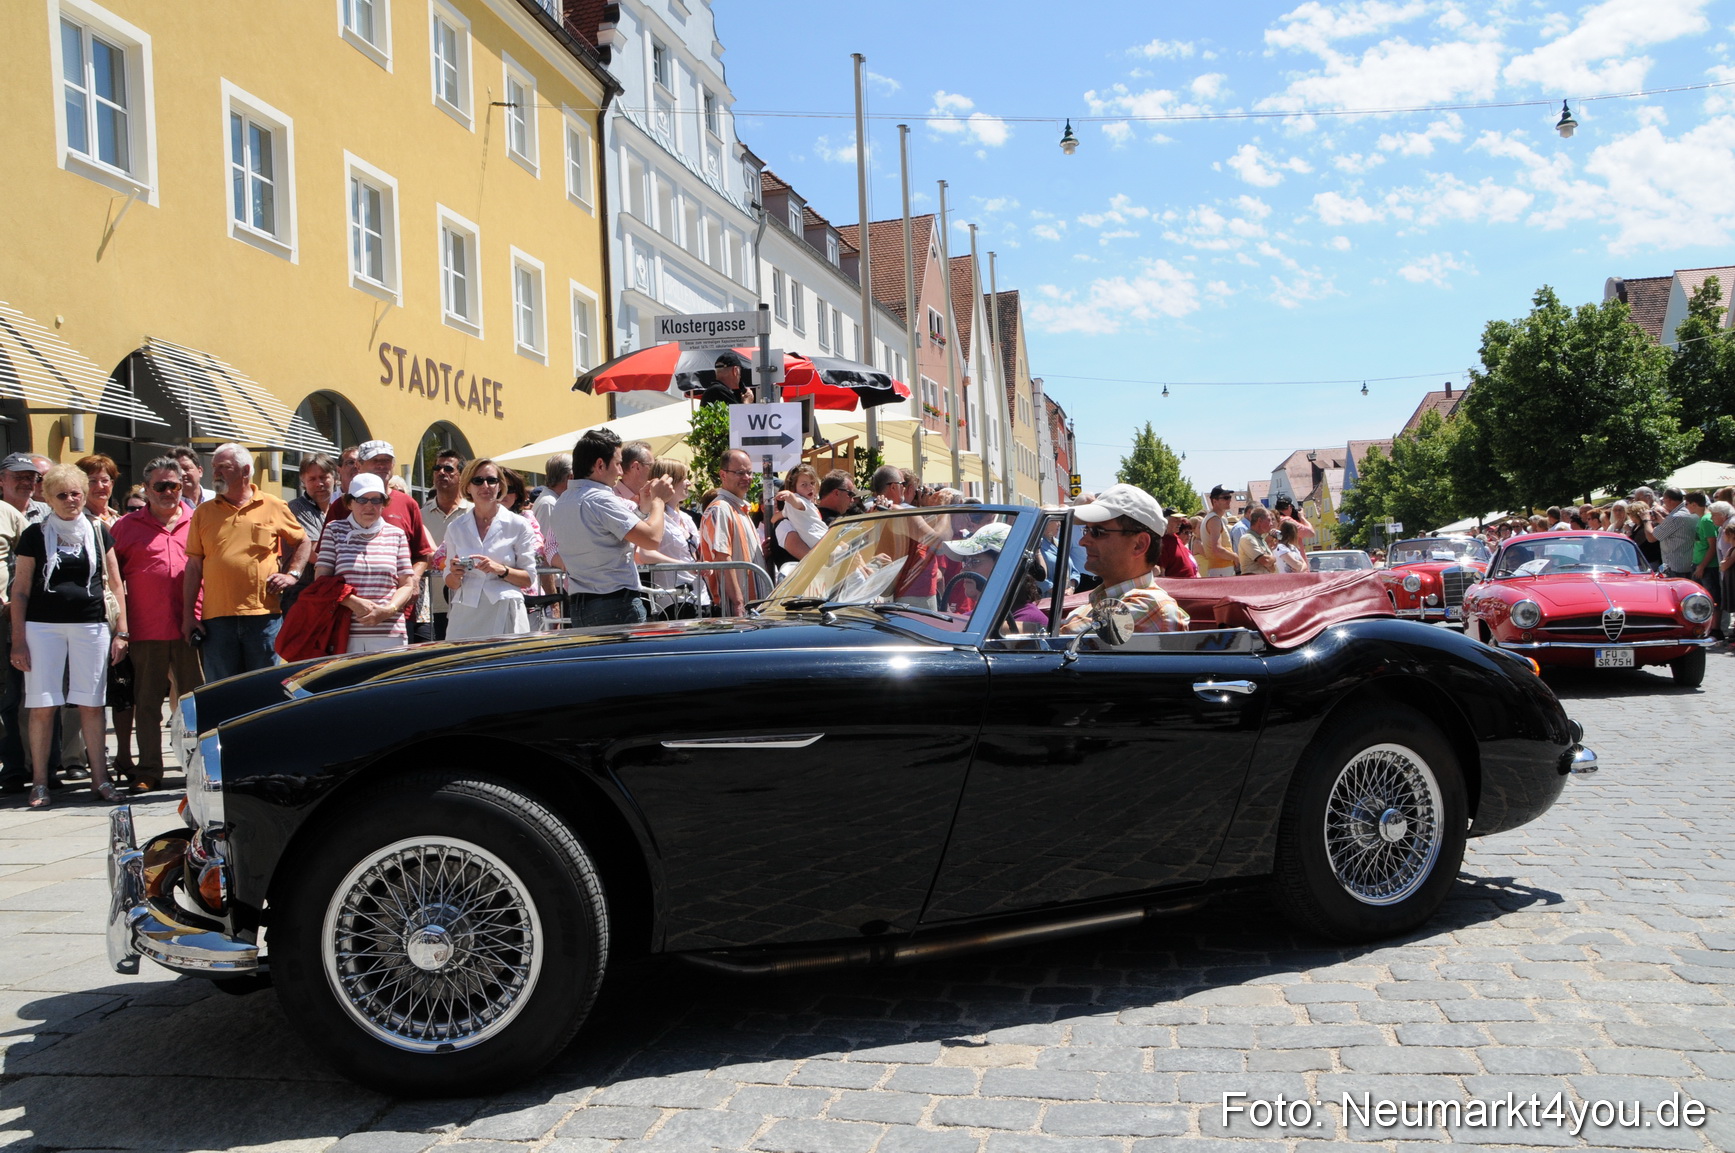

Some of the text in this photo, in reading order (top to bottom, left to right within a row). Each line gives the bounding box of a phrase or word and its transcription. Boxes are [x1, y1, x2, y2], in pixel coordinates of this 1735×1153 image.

[661, 318, 746, 337] Klostergasse
[379, 342, 504, 419] STADTCAFE
[747, 413, 782, 431] WC
